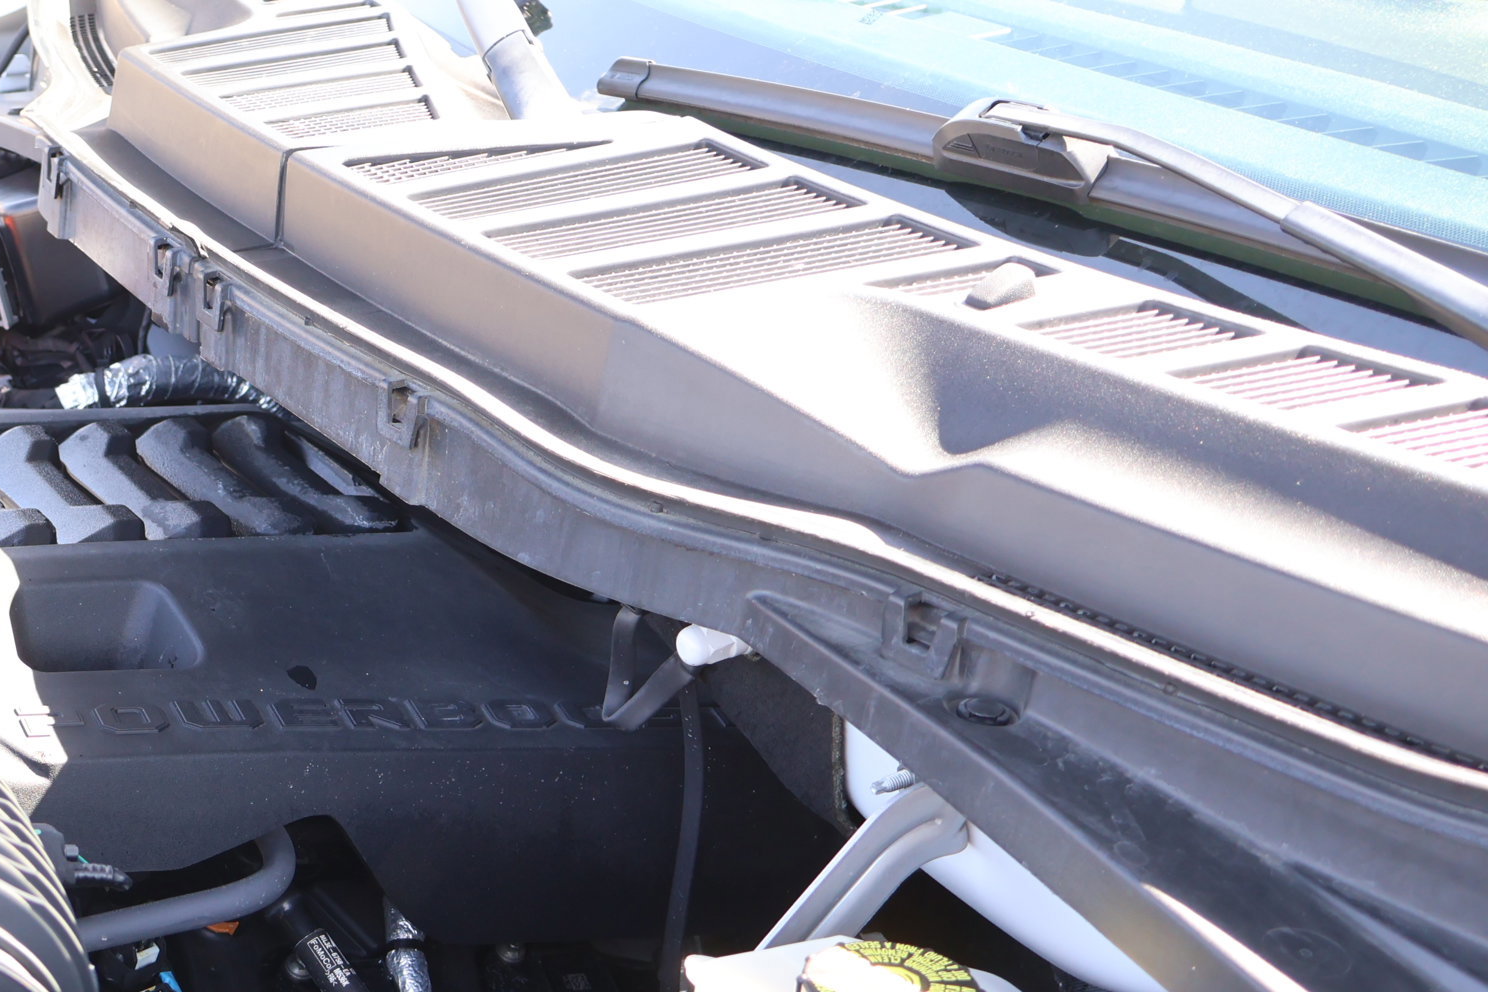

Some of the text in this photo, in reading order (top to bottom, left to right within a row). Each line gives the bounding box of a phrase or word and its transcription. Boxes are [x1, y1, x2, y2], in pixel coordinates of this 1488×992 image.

[884, 941, 892, 949] A
[896, 943, 924, 957] FROM
[309, 939, 332, 970] FoMoCo
[868, 956, 901, 964] CLEAN
